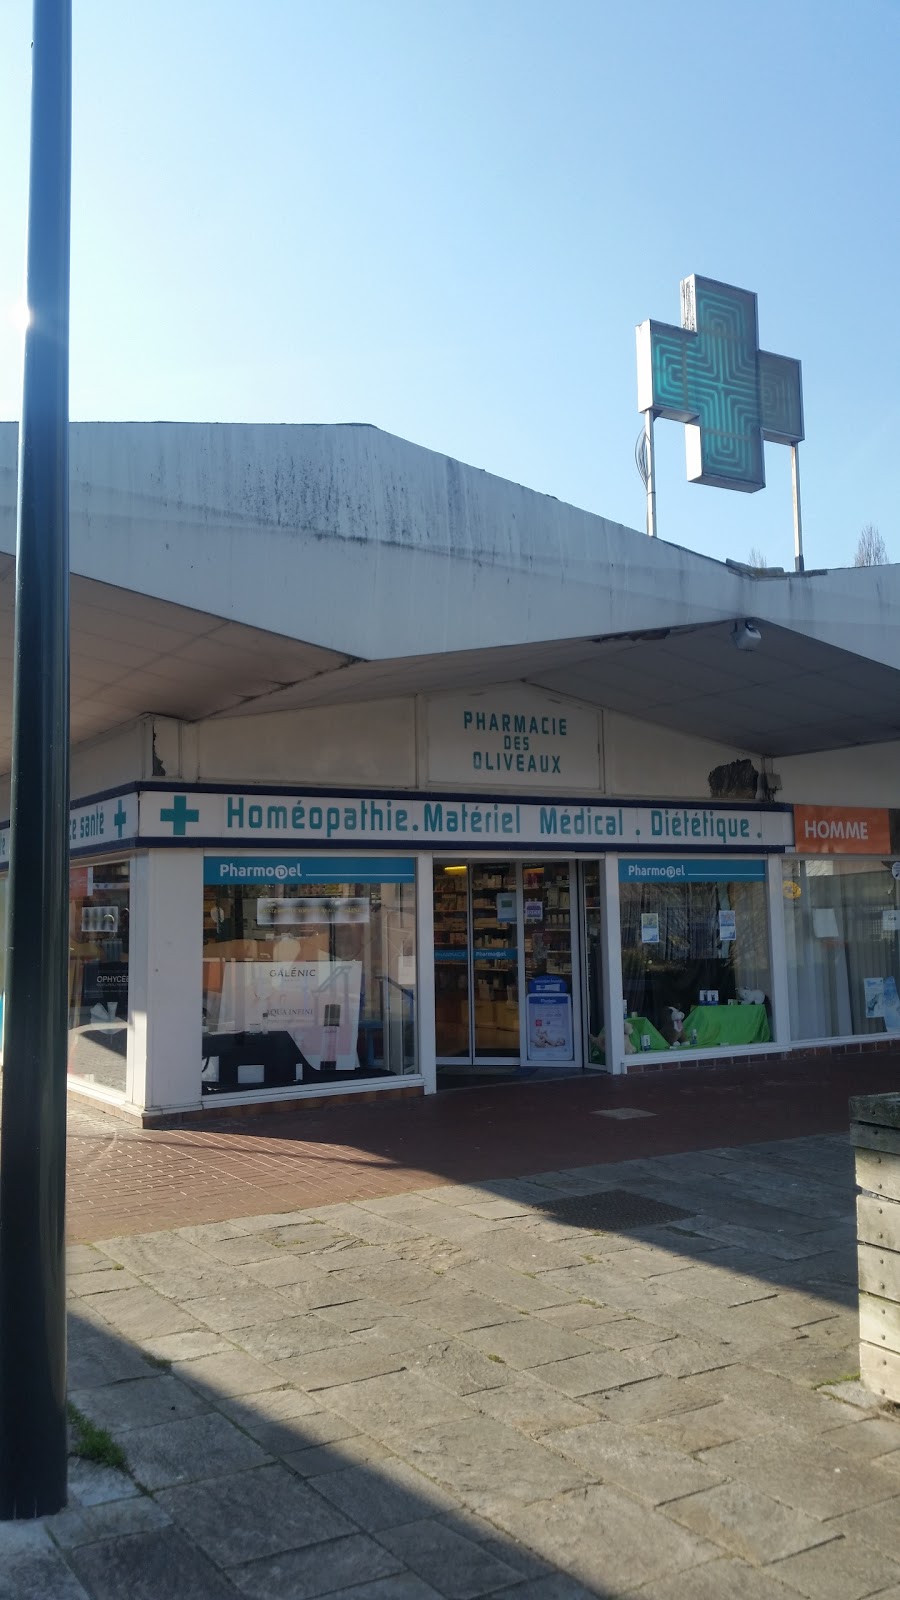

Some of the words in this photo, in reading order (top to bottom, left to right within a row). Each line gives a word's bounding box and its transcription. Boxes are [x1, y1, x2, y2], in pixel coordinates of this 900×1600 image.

[464, 710, 567, 736] PHARMACIE
[504, 735, 530, 751] DES
[473, 751, 561, 774] OLIVEAUX
[80, 805, 105, 839] santé
[423, 803, 521, 834] Matériel
[539, 806, 623, 836] Médical
[804, 819, 869, 840] HOMME
[269, 967, 317, 978] GALÉNIC
